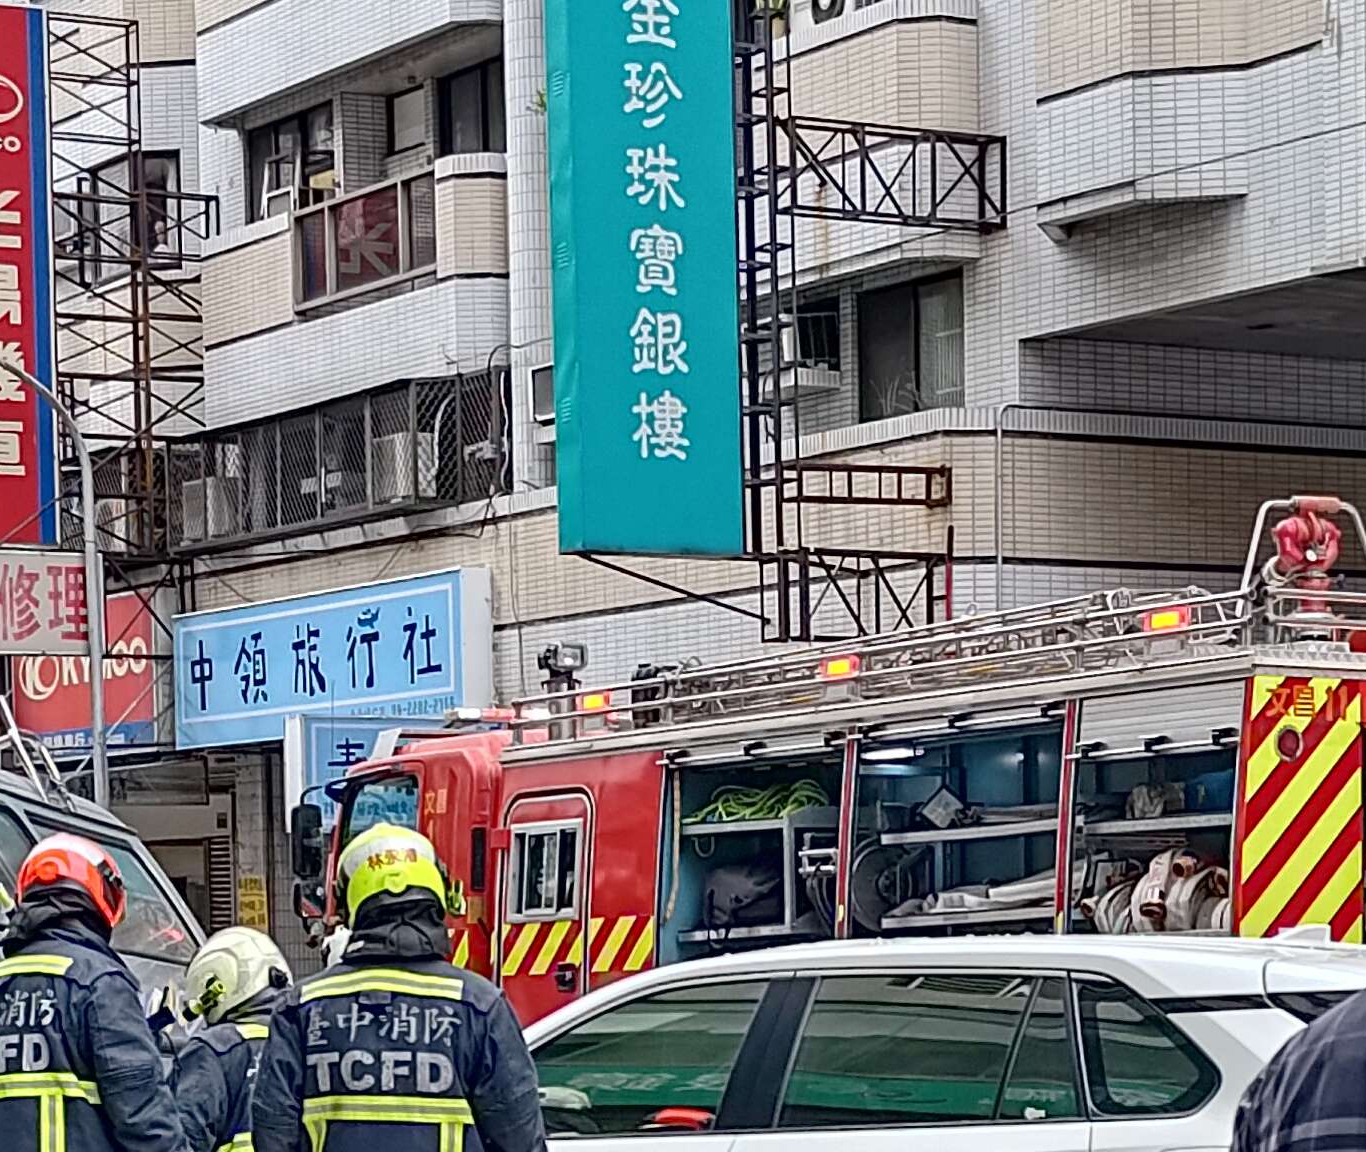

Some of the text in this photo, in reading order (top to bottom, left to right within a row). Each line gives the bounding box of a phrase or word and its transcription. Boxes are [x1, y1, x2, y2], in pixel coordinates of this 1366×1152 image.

[622, 0, 691, 461] 金珍珠寶銀樓
[190, 606, 443, 711] 中領旅行社
[306, 1050, 454, 1093] TCFD
